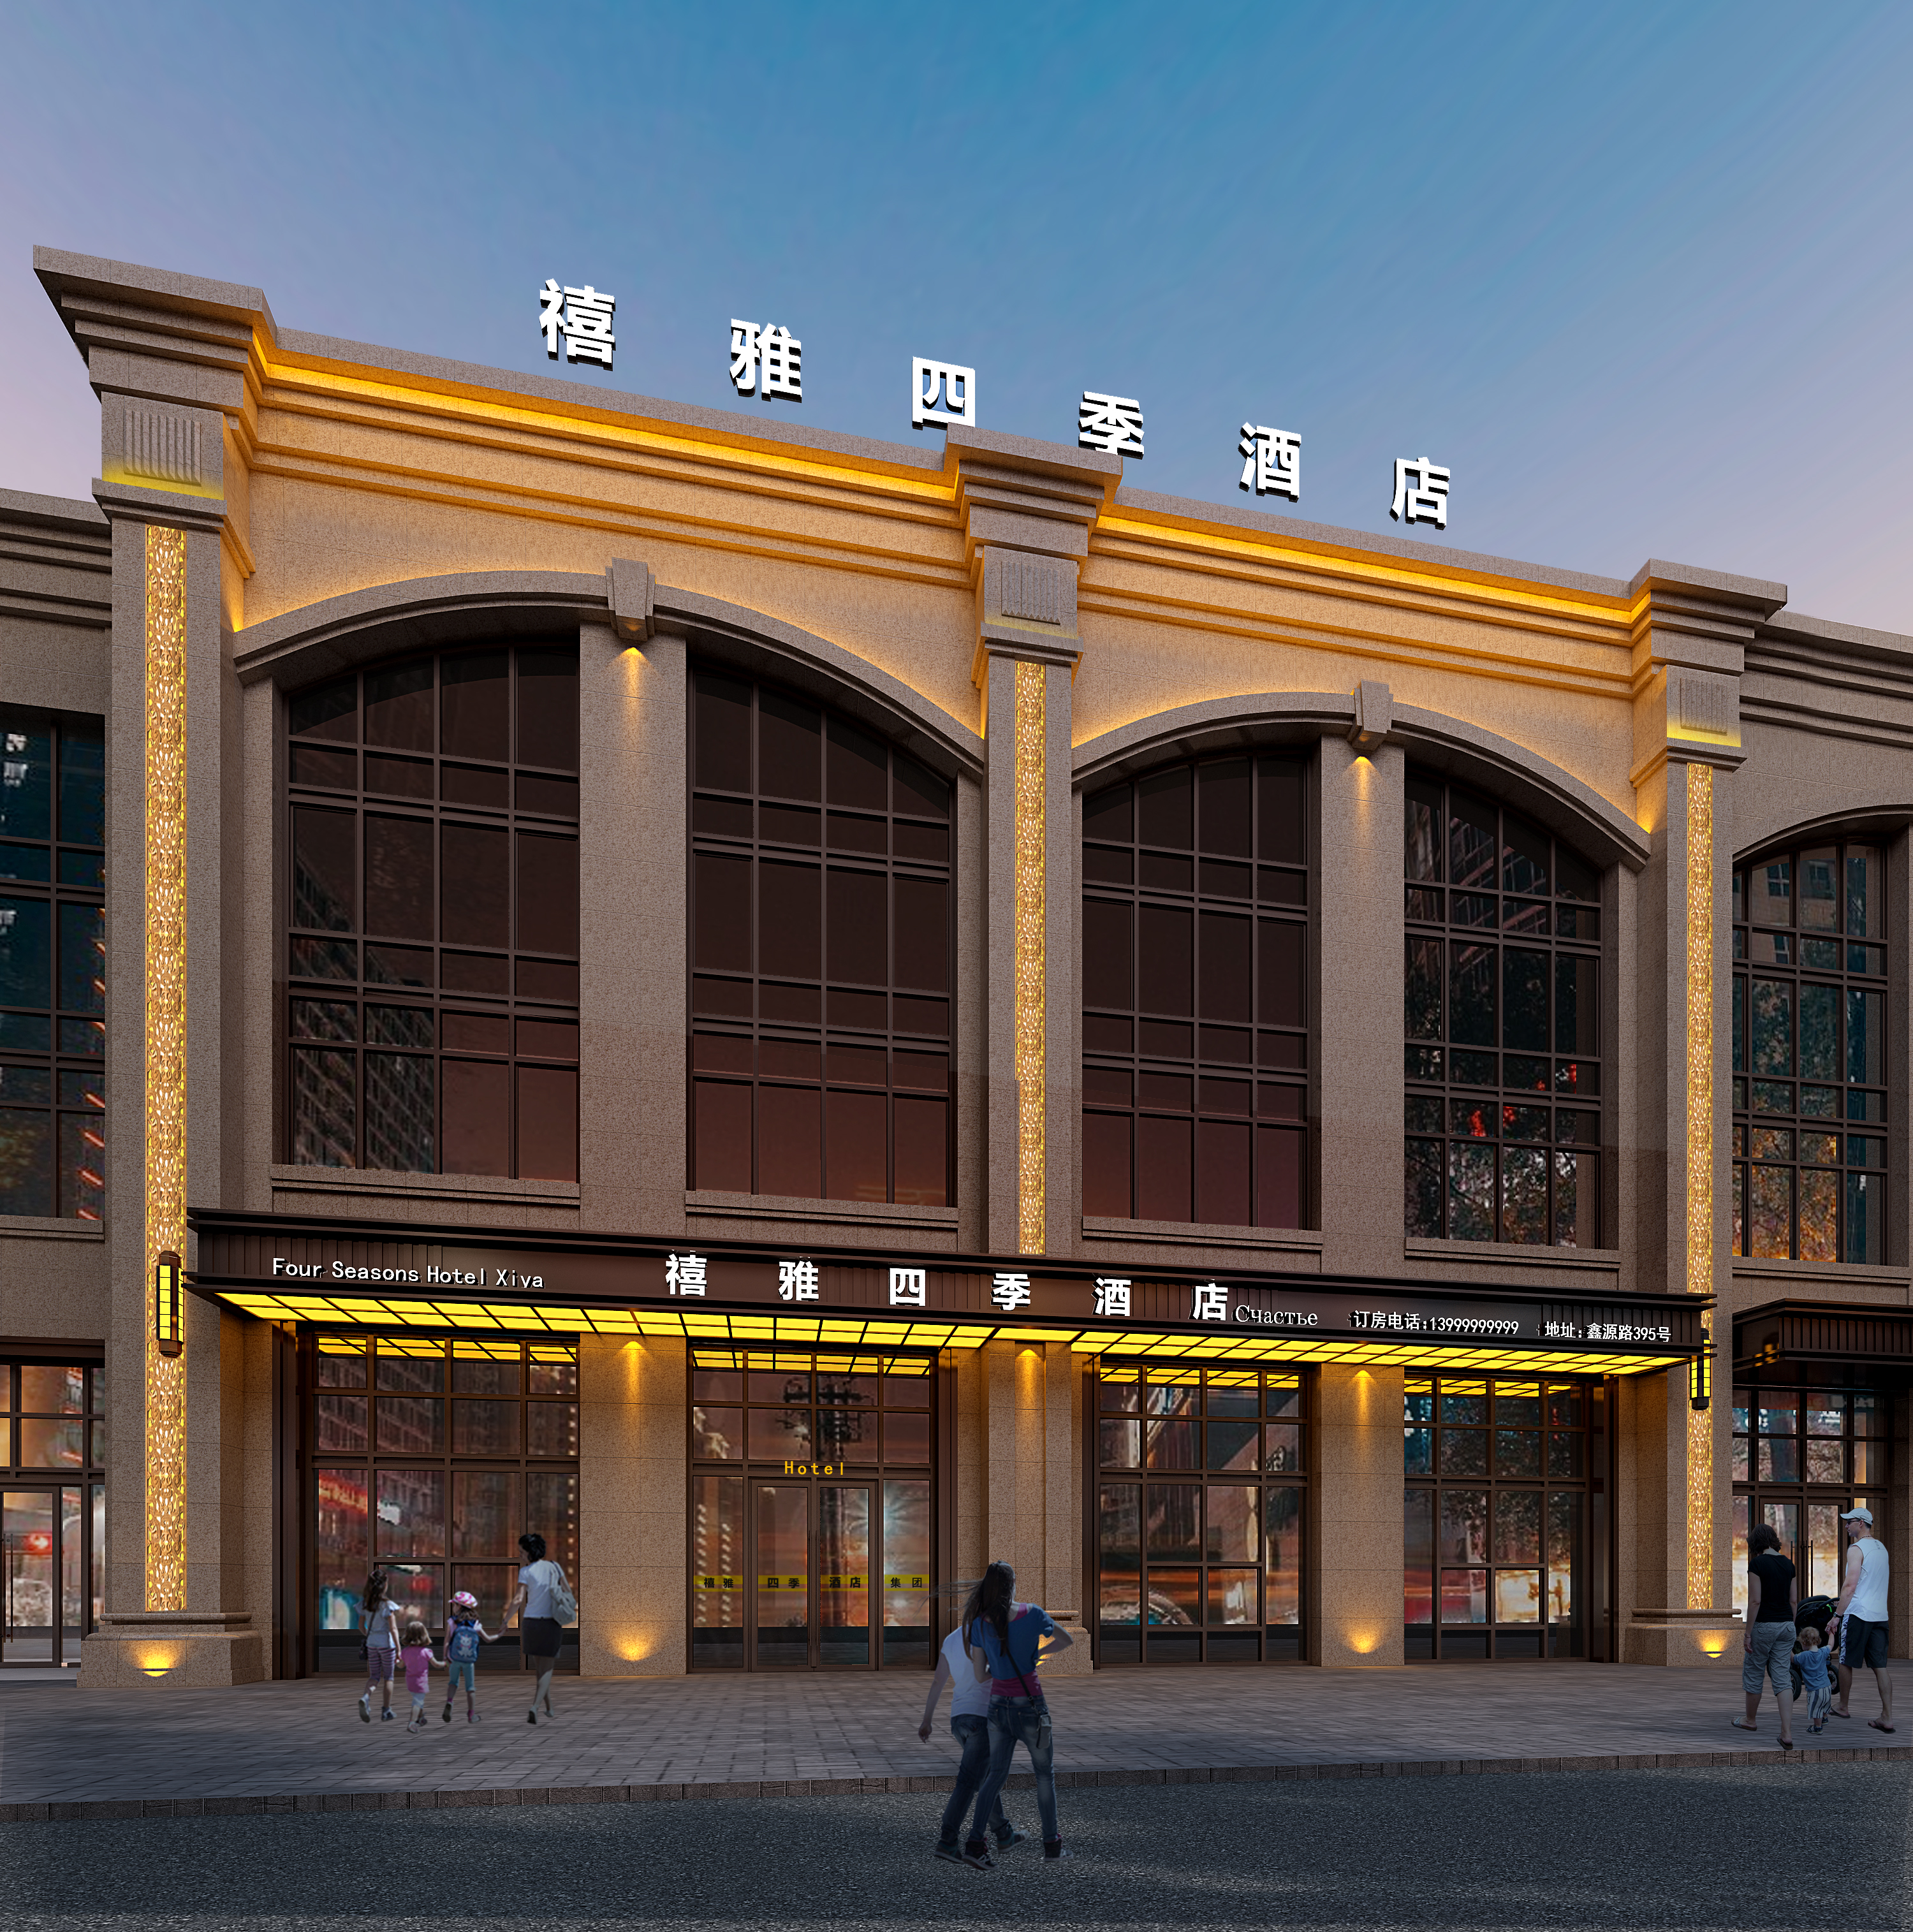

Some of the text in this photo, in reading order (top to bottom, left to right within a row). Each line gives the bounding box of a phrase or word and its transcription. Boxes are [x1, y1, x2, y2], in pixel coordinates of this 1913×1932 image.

[273, 1257, 322, 1278] Four
[332, 1261, 419, 1282] Seasons
[427, 1265, 484, 1285] Hotel
[665, 1253, 1228, 1321] 禧雅四季酒店
[1235, 1305, 1318, 1326] Счастье
[784, 1461, 844, 1475] Hotel
